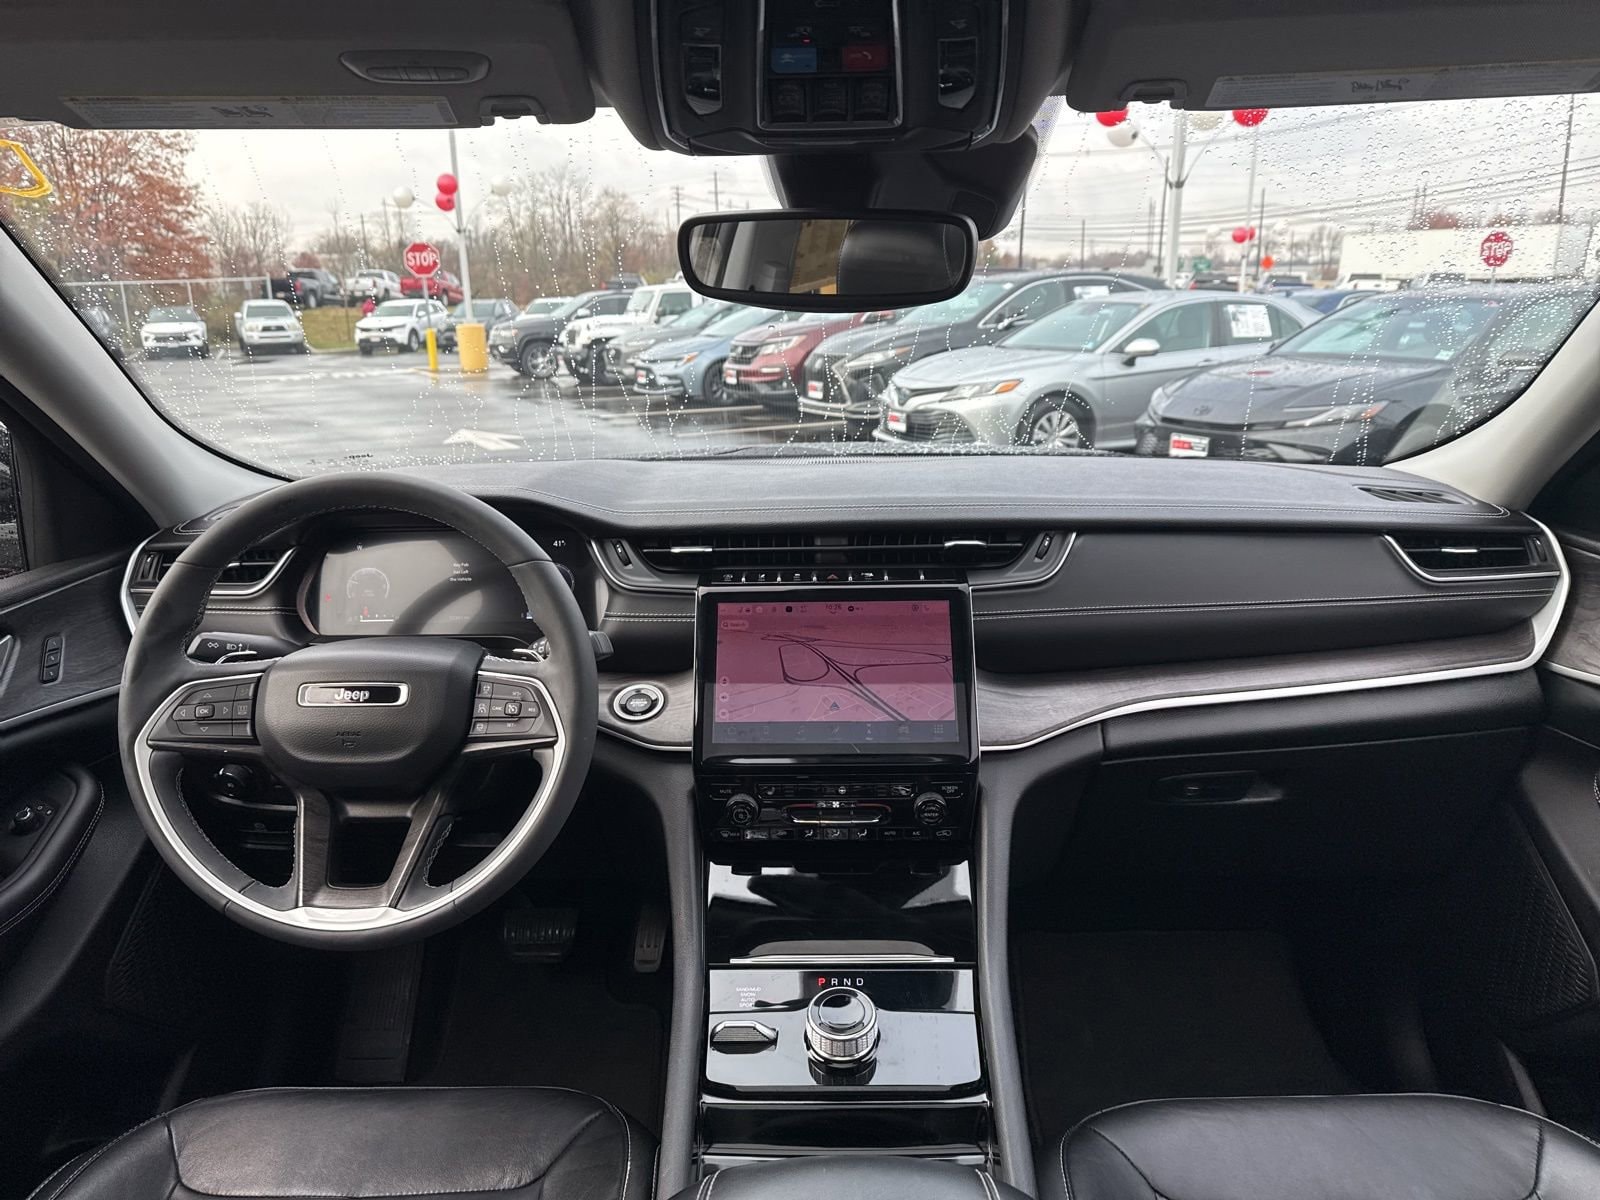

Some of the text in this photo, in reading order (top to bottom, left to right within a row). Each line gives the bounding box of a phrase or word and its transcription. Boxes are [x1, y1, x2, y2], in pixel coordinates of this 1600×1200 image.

[1482, 241, 1512, 256] STOP
[407, 251, 437, 267] STOP
[334, 688, 371, 702] Jeep
[818, 978, 864, 986] P R N D
